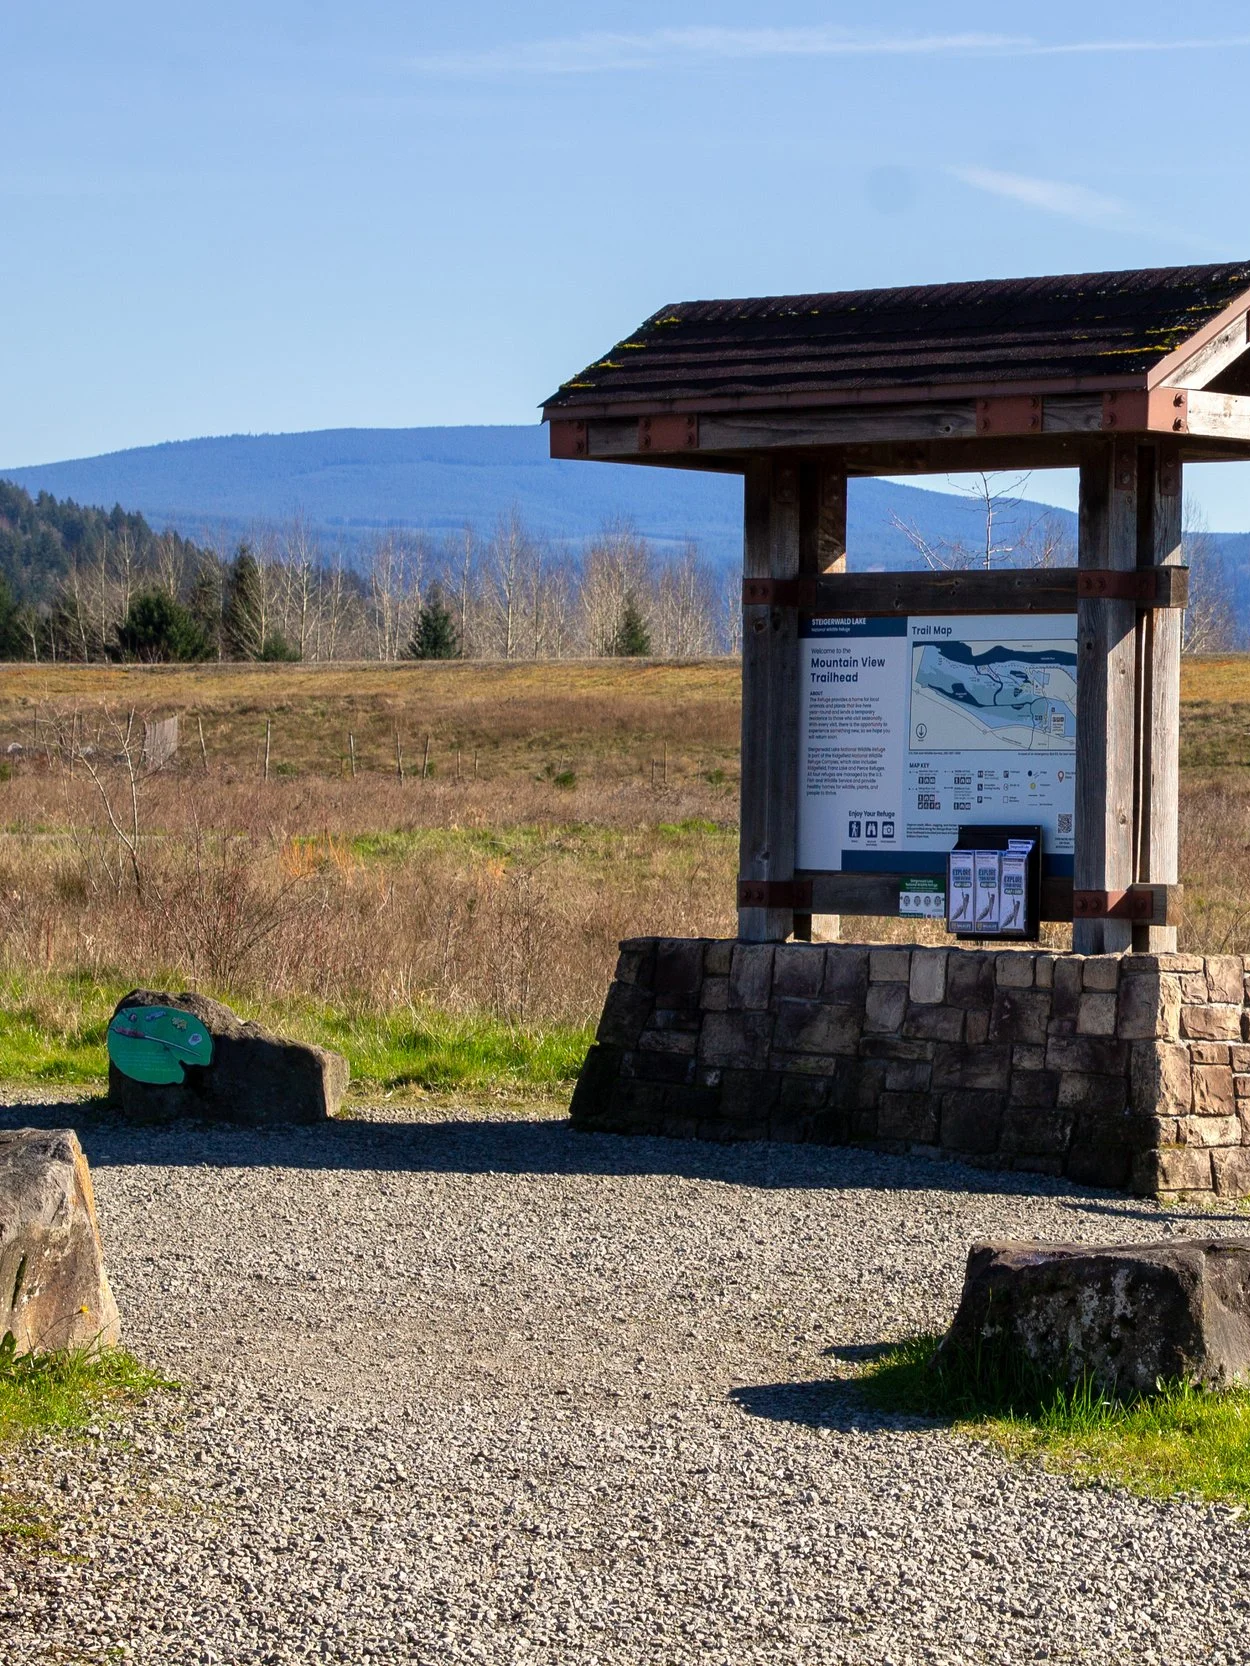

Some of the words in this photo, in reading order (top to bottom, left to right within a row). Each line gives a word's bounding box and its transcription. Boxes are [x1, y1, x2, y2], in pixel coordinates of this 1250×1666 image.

[912, 625, 931, 635] Trail
[934, 626, 952, 637] Map
[811, 656, 858, 668] Mountain
[861, 657, 886, 667] View
[811, 672, 858, 682] Trailhead
[849, 810, 862, 819] Enjoy
[877, 810, 895, 818] Refuge
